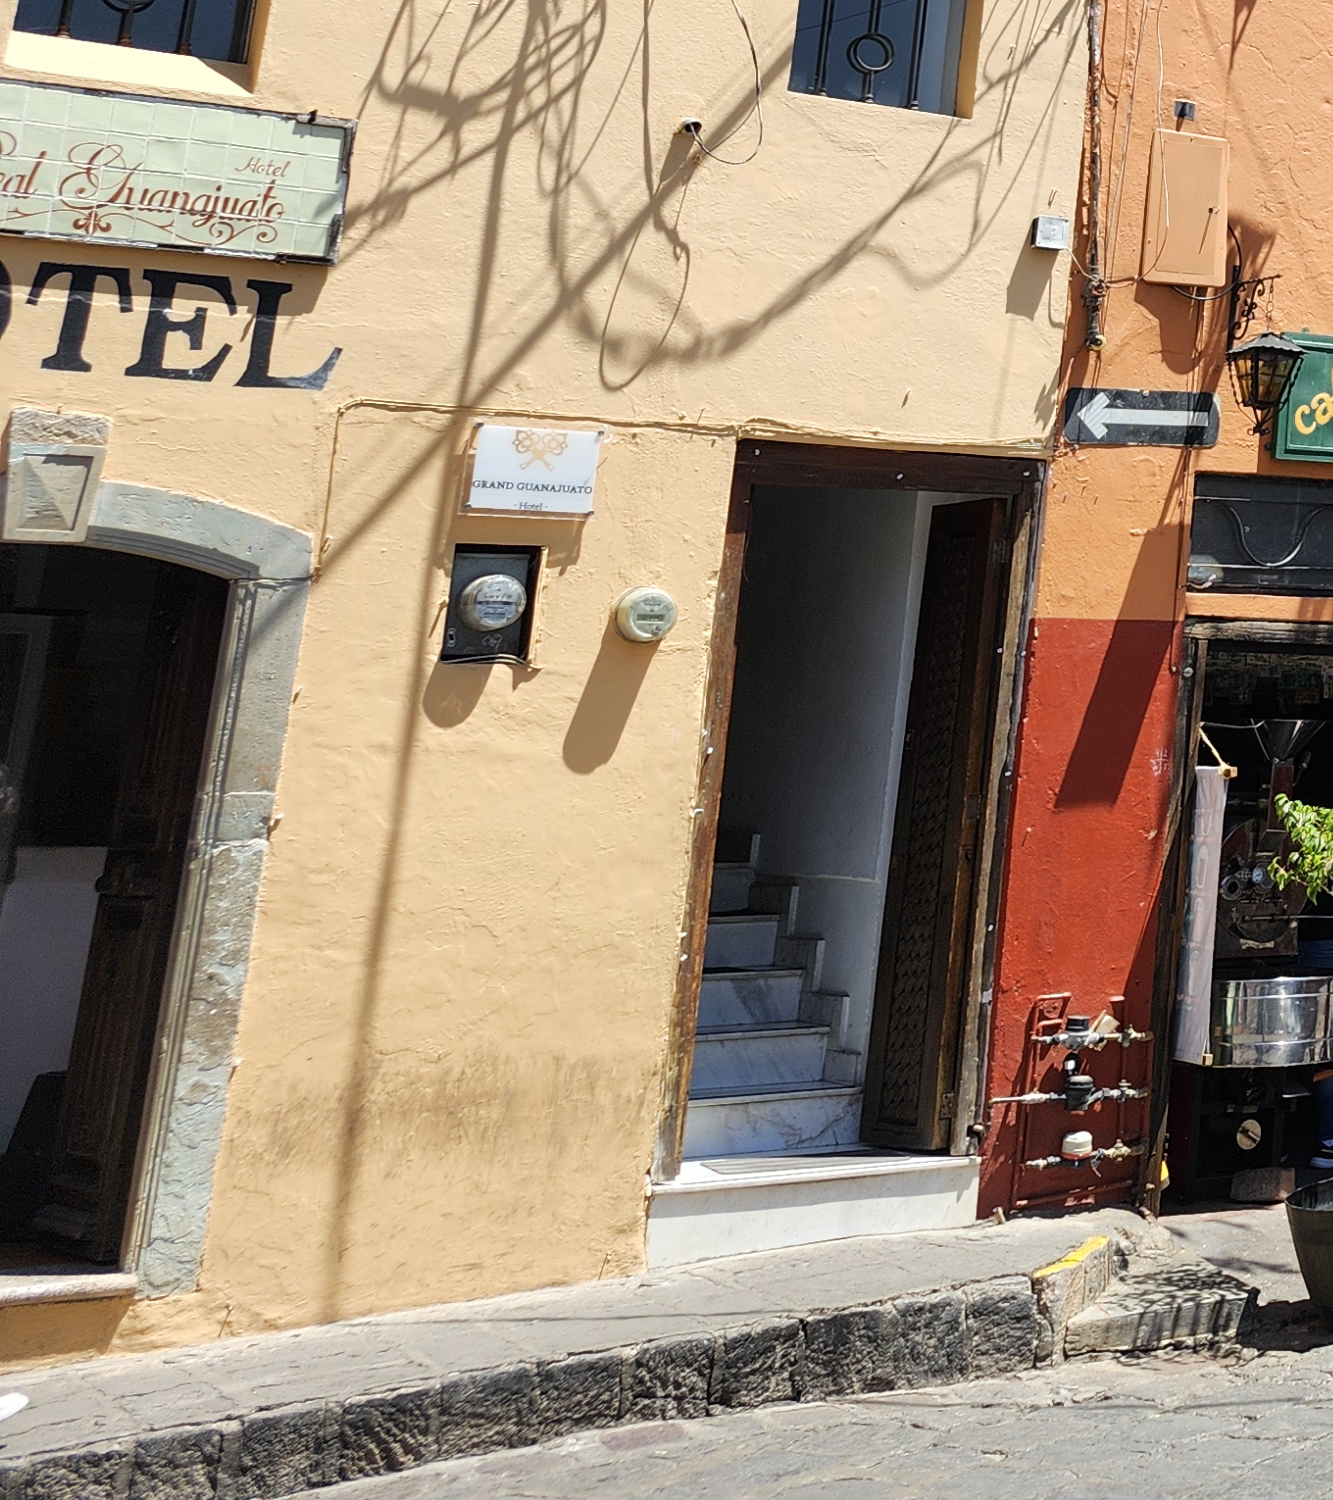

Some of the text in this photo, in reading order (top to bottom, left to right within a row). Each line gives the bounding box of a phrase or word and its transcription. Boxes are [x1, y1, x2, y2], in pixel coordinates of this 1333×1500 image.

[235, 156, 291, 179] Hotel
[59, 141, 285, 228] Guanajuato
[0, 261, 343, 392] TEL
[472, 480, 593, 495] GRAND GUANAJUATO
[519, 502, 543, 511] Hotel
